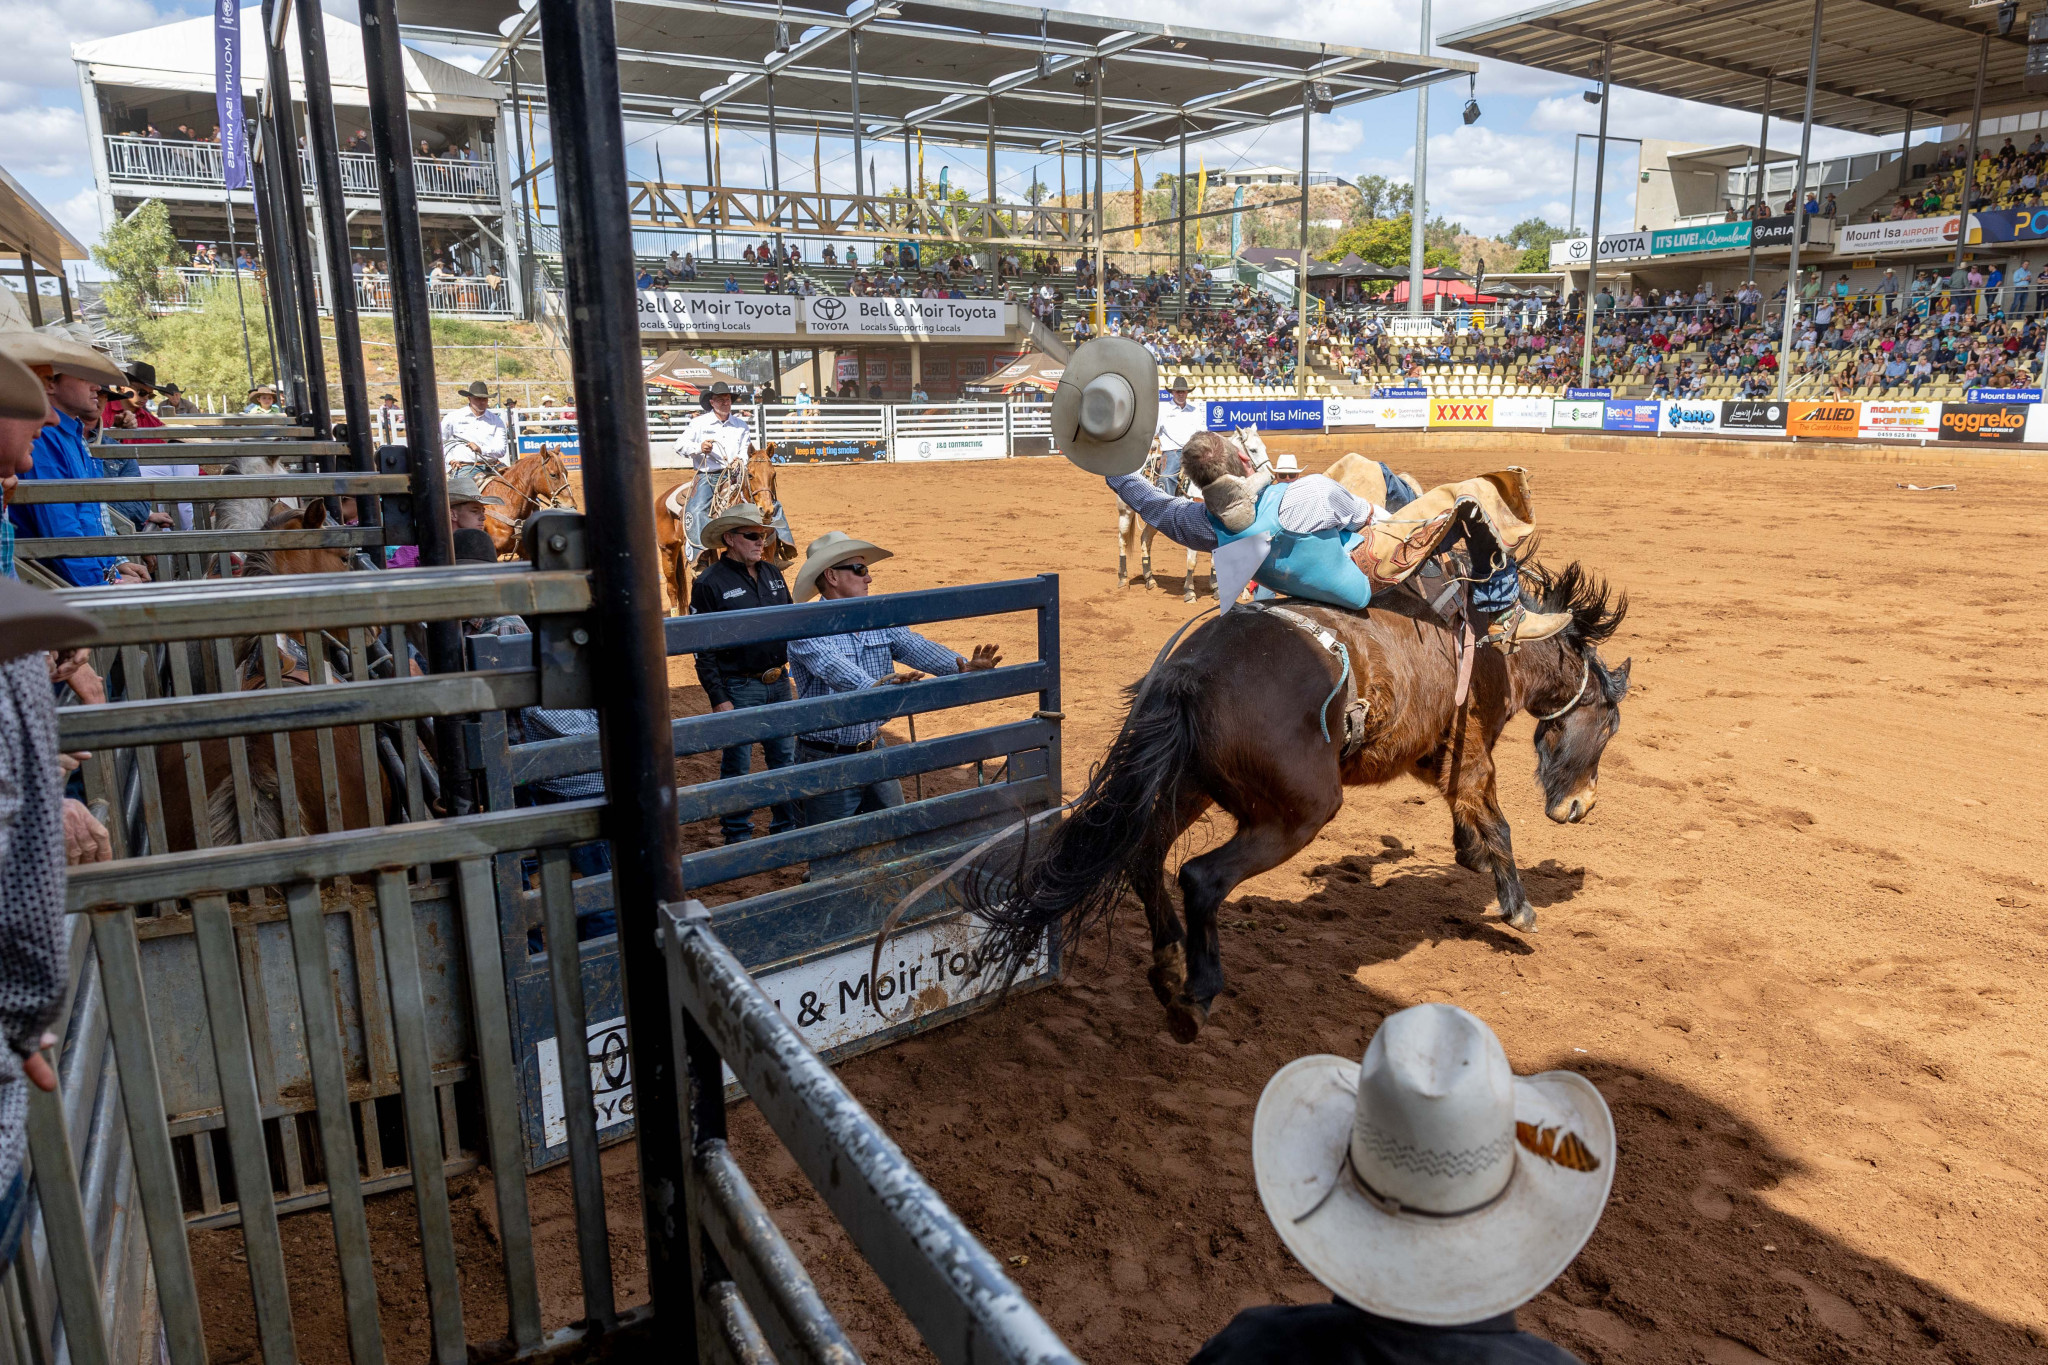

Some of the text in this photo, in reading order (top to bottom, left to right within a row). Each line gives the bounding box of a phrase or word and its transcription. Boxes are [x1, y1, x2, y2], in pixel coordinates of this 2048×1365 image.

[1655, 235, 1673, 249] IT'S
[1674, 232, 1699, 248] LIVE!
[1706, 226, 1751, 246] Queensland
[1764, 226, 1797, 237] ARIA
[1846, 227, 1940, 242] Mount Isa AIRPORT
[1597, 237, 1645, 255] OYOTA
[636, 297, 791, 319] Bell & Moir Toyota
[860, 303, 996, 322] Bell & Moir Toyota
[667, 320, 720, 332] Supporting
[722, 321, 751, 331] Locals
[811, 322, 849, 331] TOYOTA
[860, 323, 961, 333] Locals Supporting Locals
[966, 361, 985, 375] ENZED
[1980, 392, 2041, 400] Mount Isa Mines
[1230, 410, 1268, 422] Mount
[1270, 410, 1285, 421] Isa
[1288, 408, 1321, 421] Mines
[1436, 404, 1488, 421] XXXX
[1580, 411, 1598, 419] scaff
[1805, 407, 1855, 421] ALLIED
[1870, 406, 1930, 415] MOUNT ISA
[1871, 417, 1925, 426] SKIP BINS
[1941, 408, 2025, 433] aggreko
[1811, 424, 1831, 432] Careful
[1832, 424, 1854, 432] Movers
[795, 446, 809, 456] keep
[810, 447, 816, 455] at
[837, 446, 859, 455] smokes
[948, 440, 983, 449] CONTRACTING
[797, 936, 1016, 1027] & Moir Toyo
